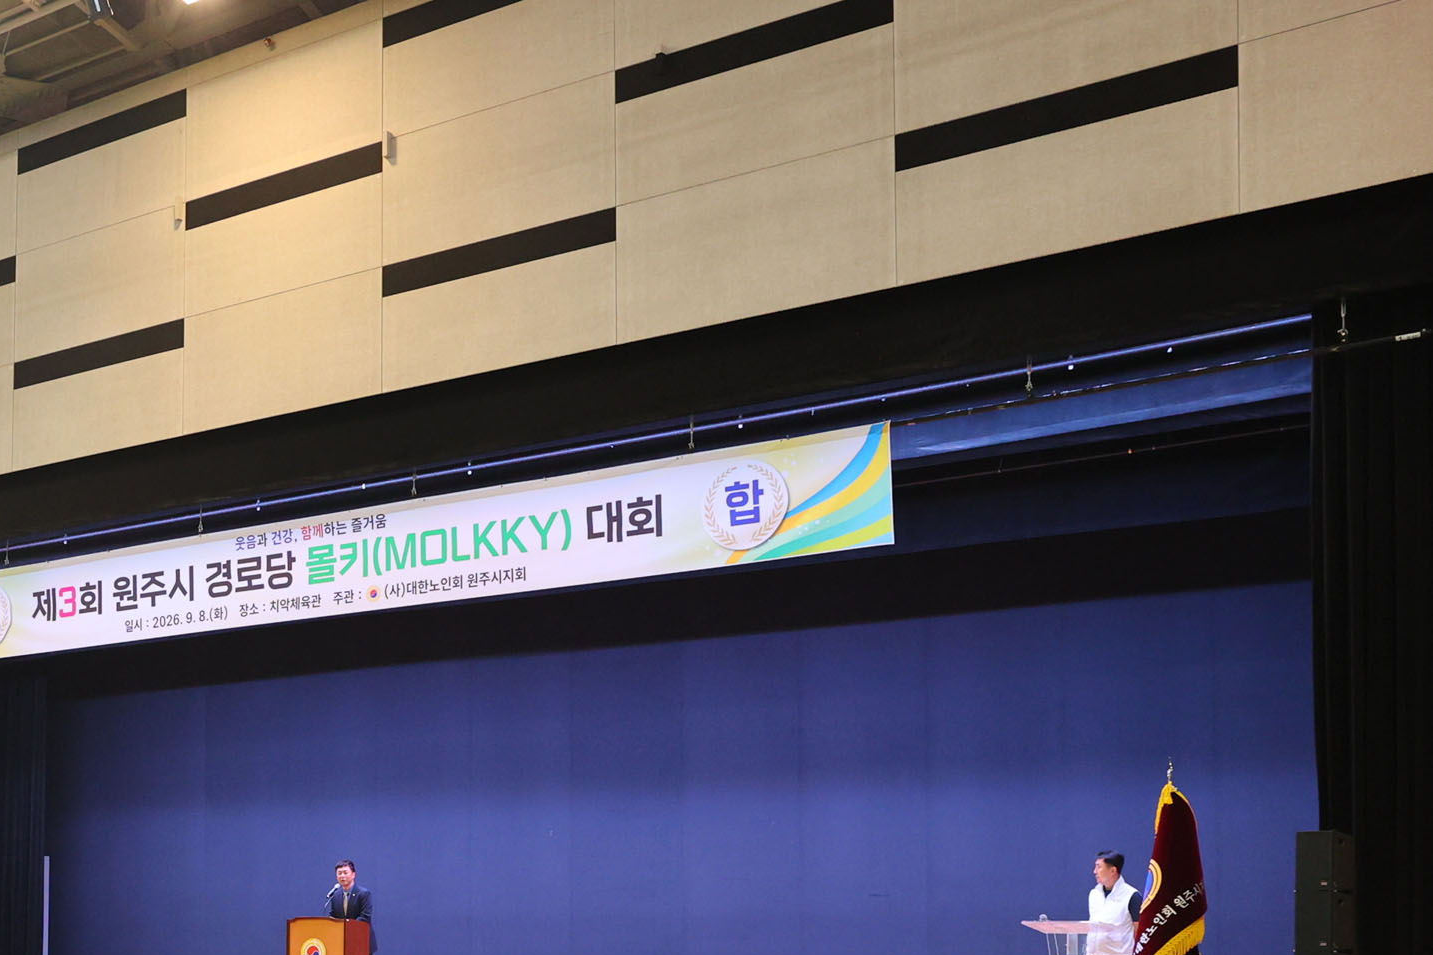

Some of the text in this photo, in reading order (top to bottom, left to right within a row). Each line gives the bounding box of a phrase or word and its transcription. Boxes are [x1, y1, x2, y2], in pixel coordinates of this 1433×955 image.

[724, 479, 764, 527] 합
[235, 513, 387, 551] 웃음과 건강, 함께하는 즐거움
[31, 493, 663, 622] 제3회 원주시 경로당 몰키(MOLKKY) 대회
[124, 618, 143, 633] 일시
[152, 613, 183, 629] 2026.
[185, 611, 196, 624] 9.
[239, 603, 260, 617] 장소
[269, 593, 322, 613] 치악체육관
[332, 589, 355, 606] 주관
[384, 574, 464, 599] (사)대한노인회
[466, 566, 527, 589] 원주시지회
[1173, 882, 1205, 909] 원주시
